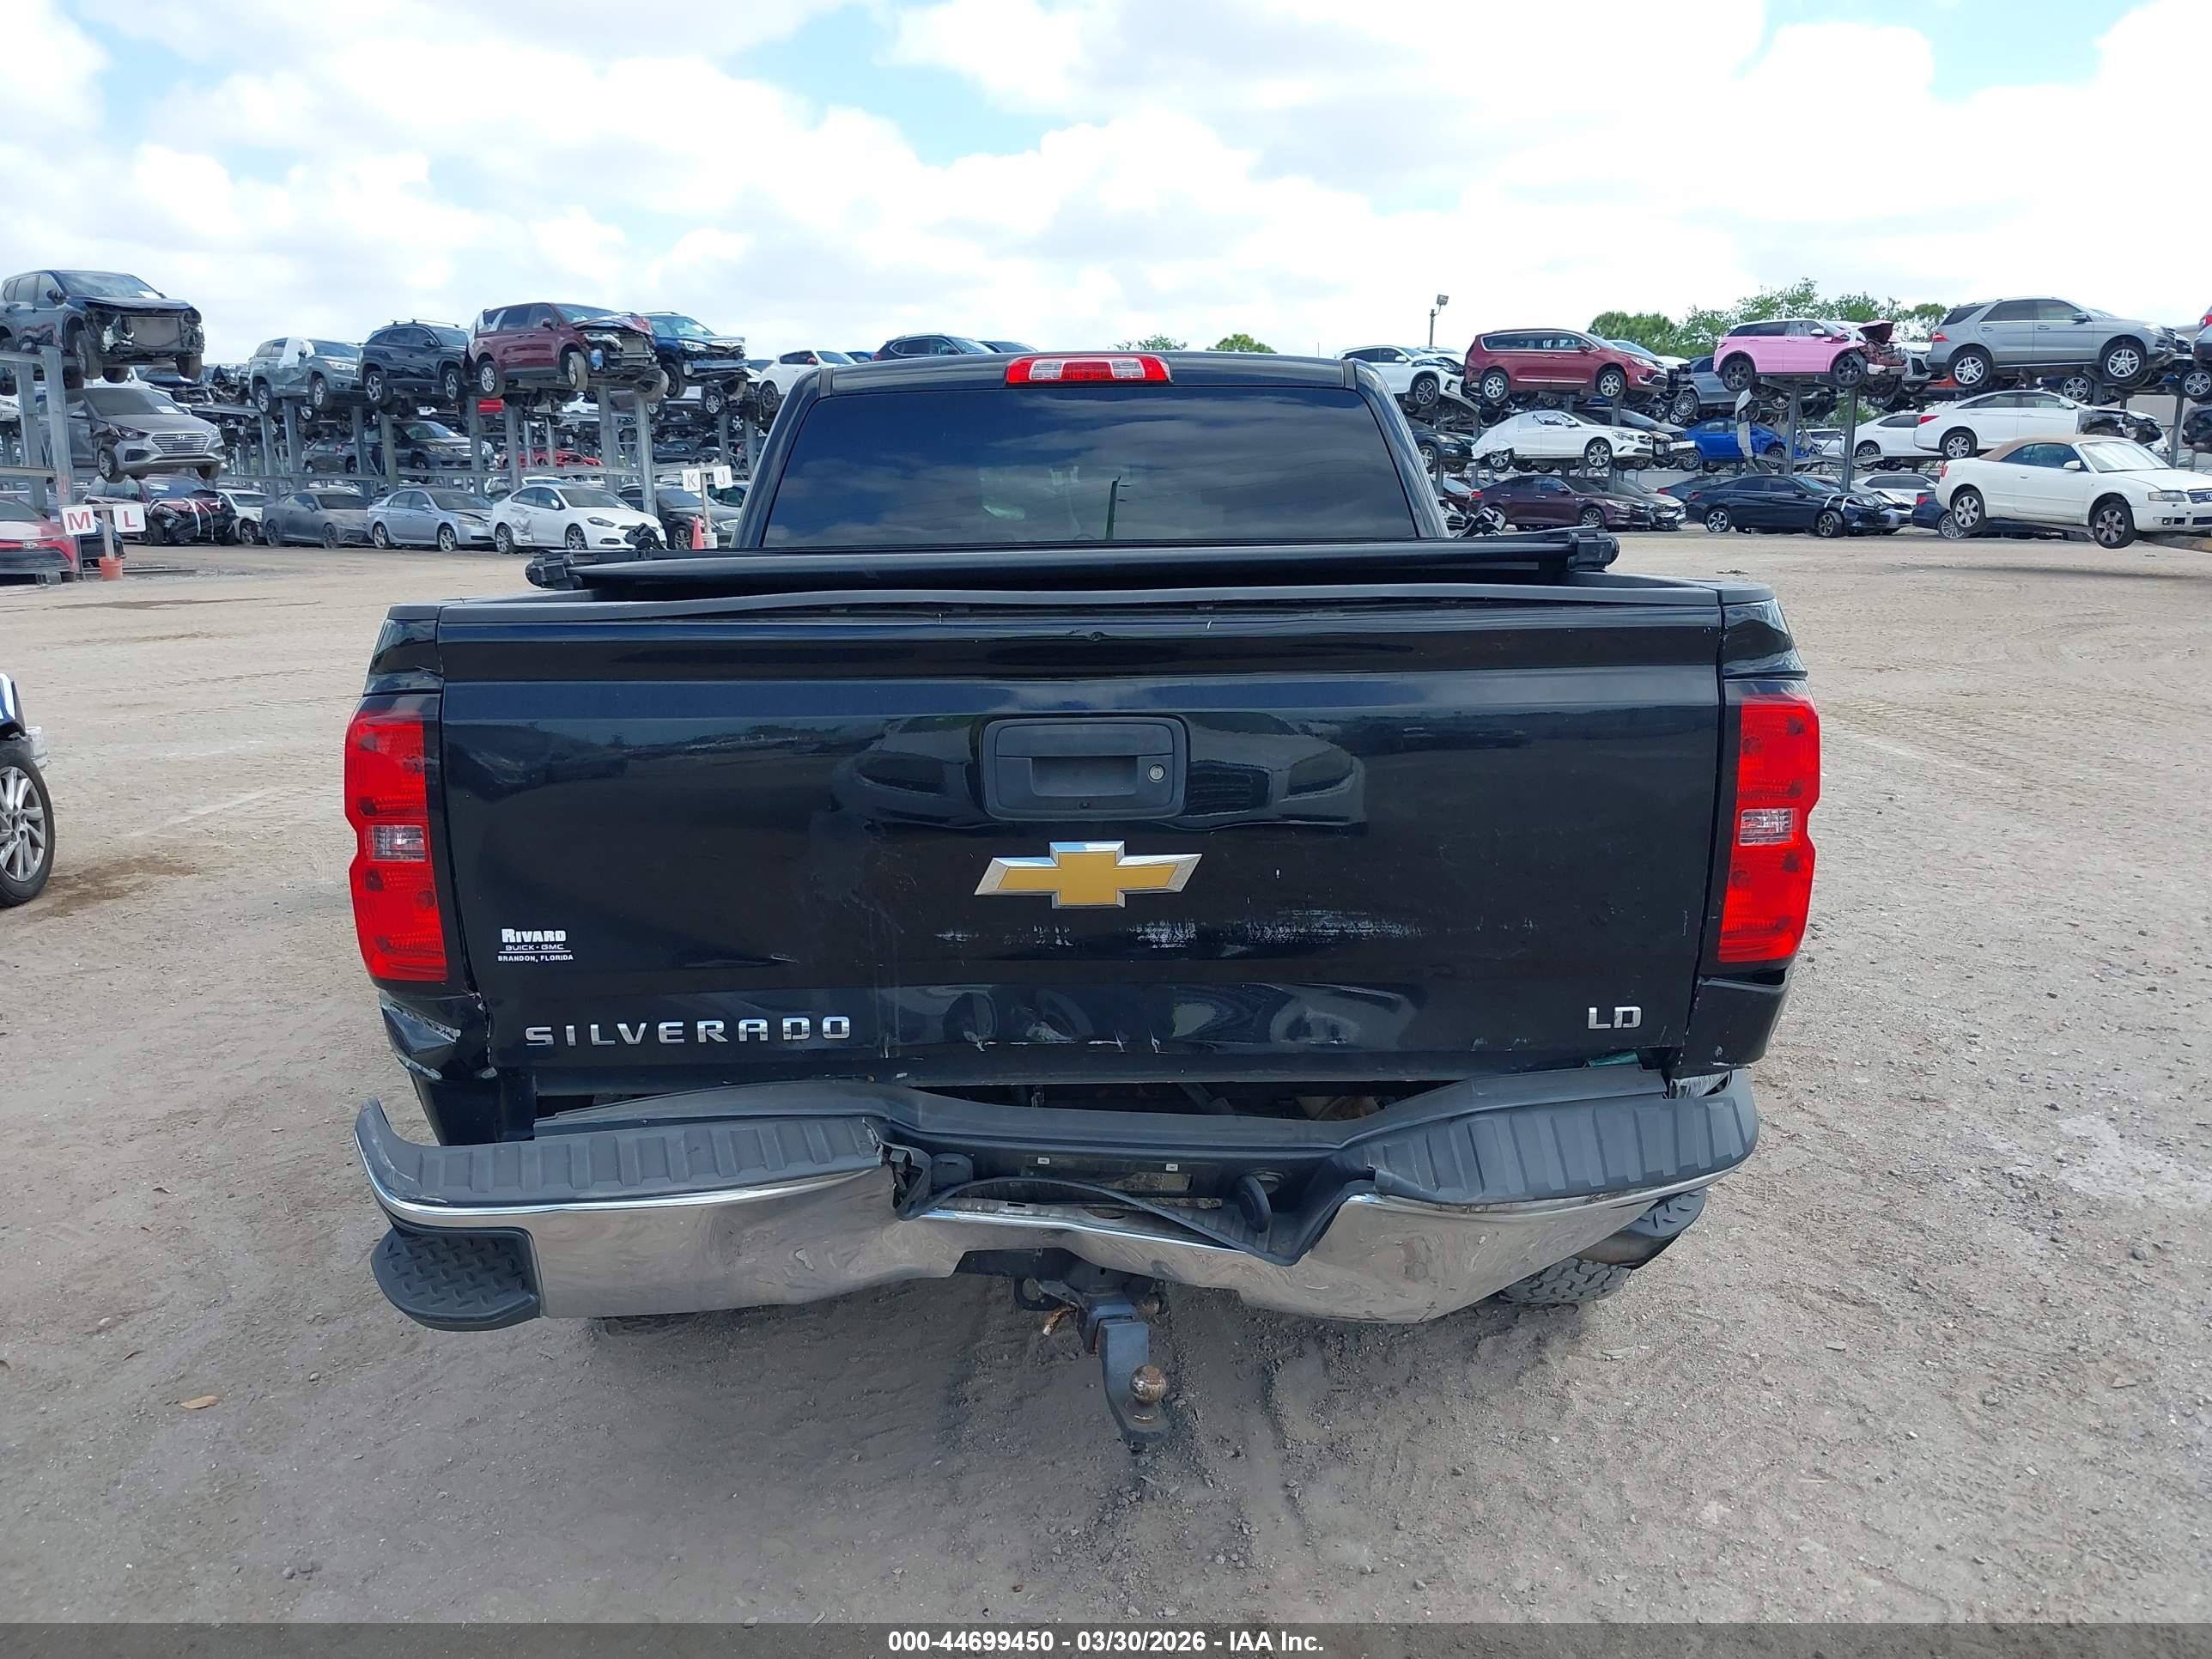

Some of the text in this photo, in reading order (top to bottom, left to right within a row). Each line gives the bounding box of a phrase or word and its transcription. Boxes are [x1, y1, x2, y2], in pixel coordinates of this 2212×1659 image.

[687, 473, 696, 487] K
[718, 471, 726, 484] J
[67, 511, 92, 531] M
[123, 510, 138, 527] L
[1588, 1006, 1642, 1029] LD
[525, 1016, 851, 1047] SILVERADO
